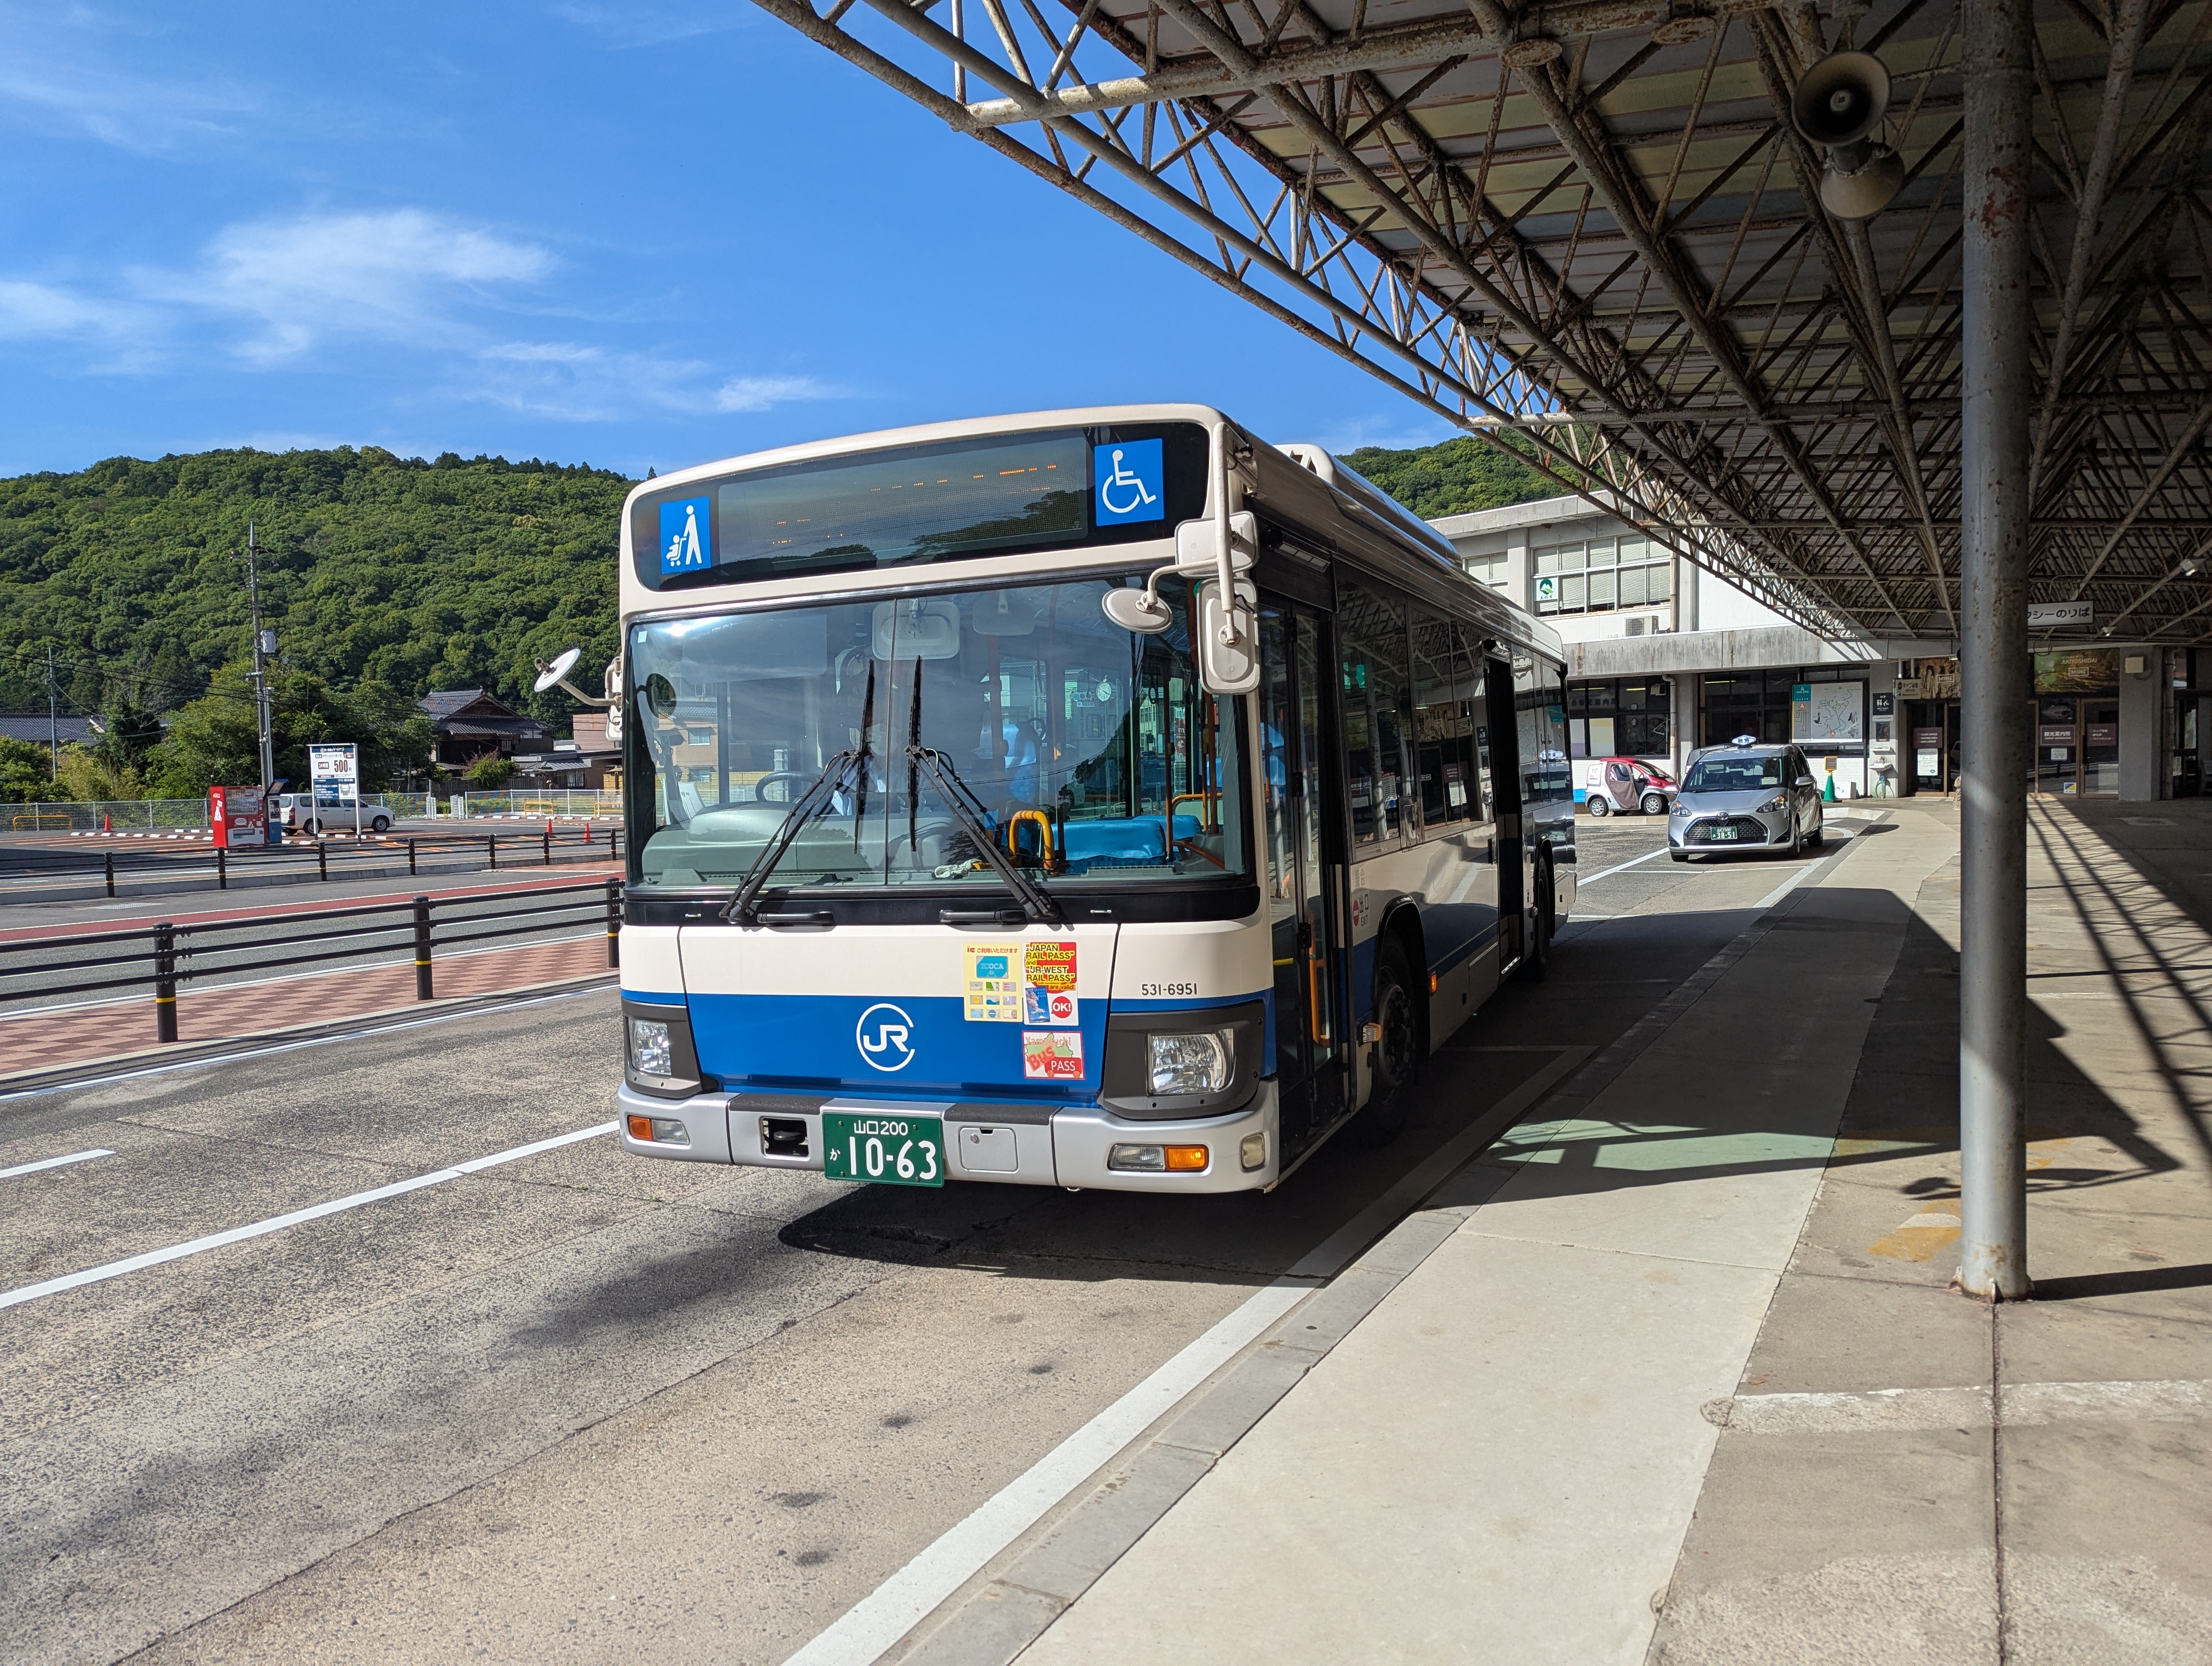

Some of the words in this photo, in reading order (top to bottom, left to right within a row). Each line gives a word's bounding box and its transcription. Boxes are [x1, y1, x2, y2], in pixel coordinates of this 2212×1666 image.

[334, 760, 348, 772] 500
[1141, 983, 1197, 996] 531-6951
[1052, 1002, 1071, 1012] OK!
[863, 1024, 909, 1052] JR
[1051, 1060, 1076, 1072] PASS
[854, 1119, 908, 1136] 山口200
[829, 1148, 841, 1161] か
[849, 1136, 937, 1180] 10-63
